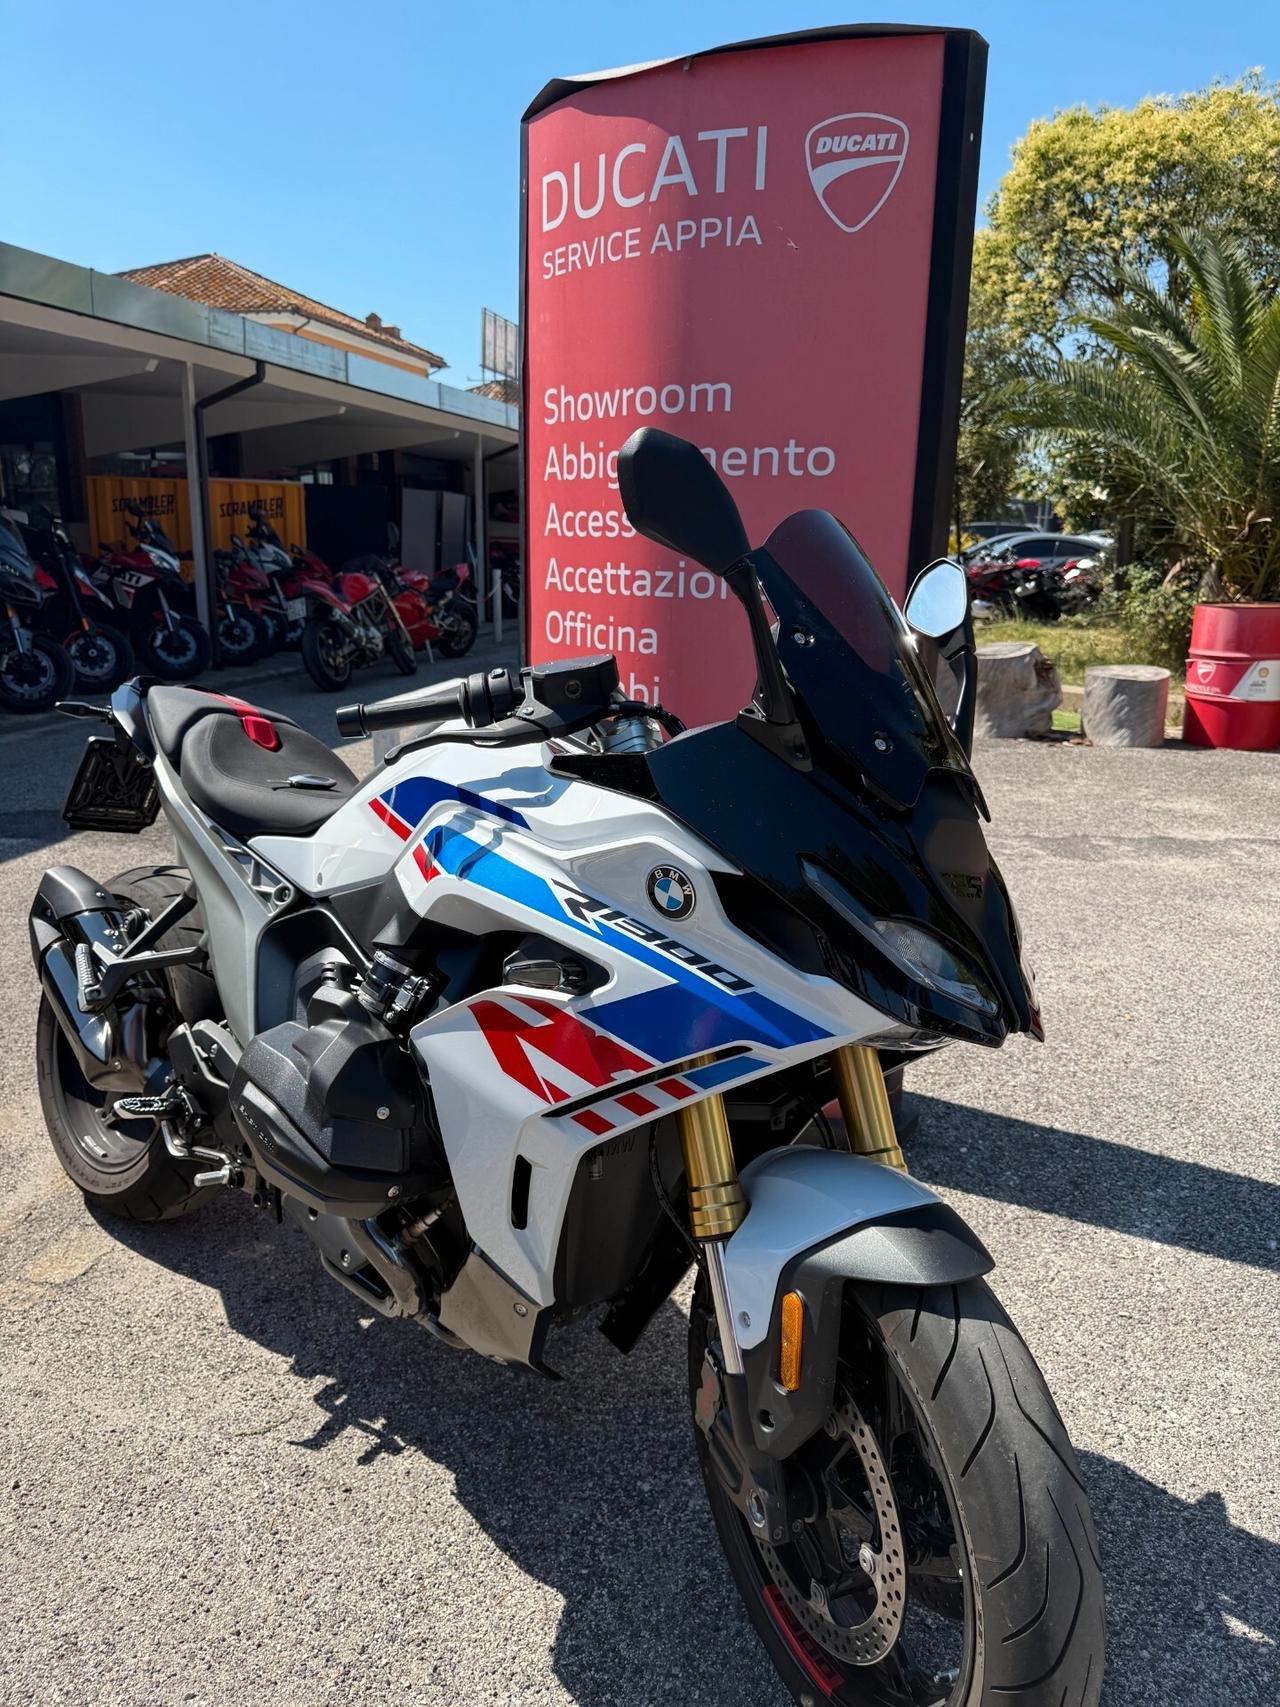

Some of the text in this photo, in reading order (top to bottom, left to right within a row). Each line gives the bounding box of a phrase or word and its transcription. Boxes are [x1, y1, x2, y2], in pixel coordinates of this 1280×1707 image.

[815, 133, 898, 154] DUCATI
[542, 125, 768, 233] DUCATI
[542, 215, 763, 280] SERVICE APPIA
[543, 380, 733, 425] Showroom
[543, 439, 837, 489] Abbigento
[112, 494, 175, 512] SCMBLER
[544, 502, 638, 538] Access
[544, 557, 728, 600] Accettazio
[545, 610, 659, 655] Officina
[654, 869, 692, 895] BMW
